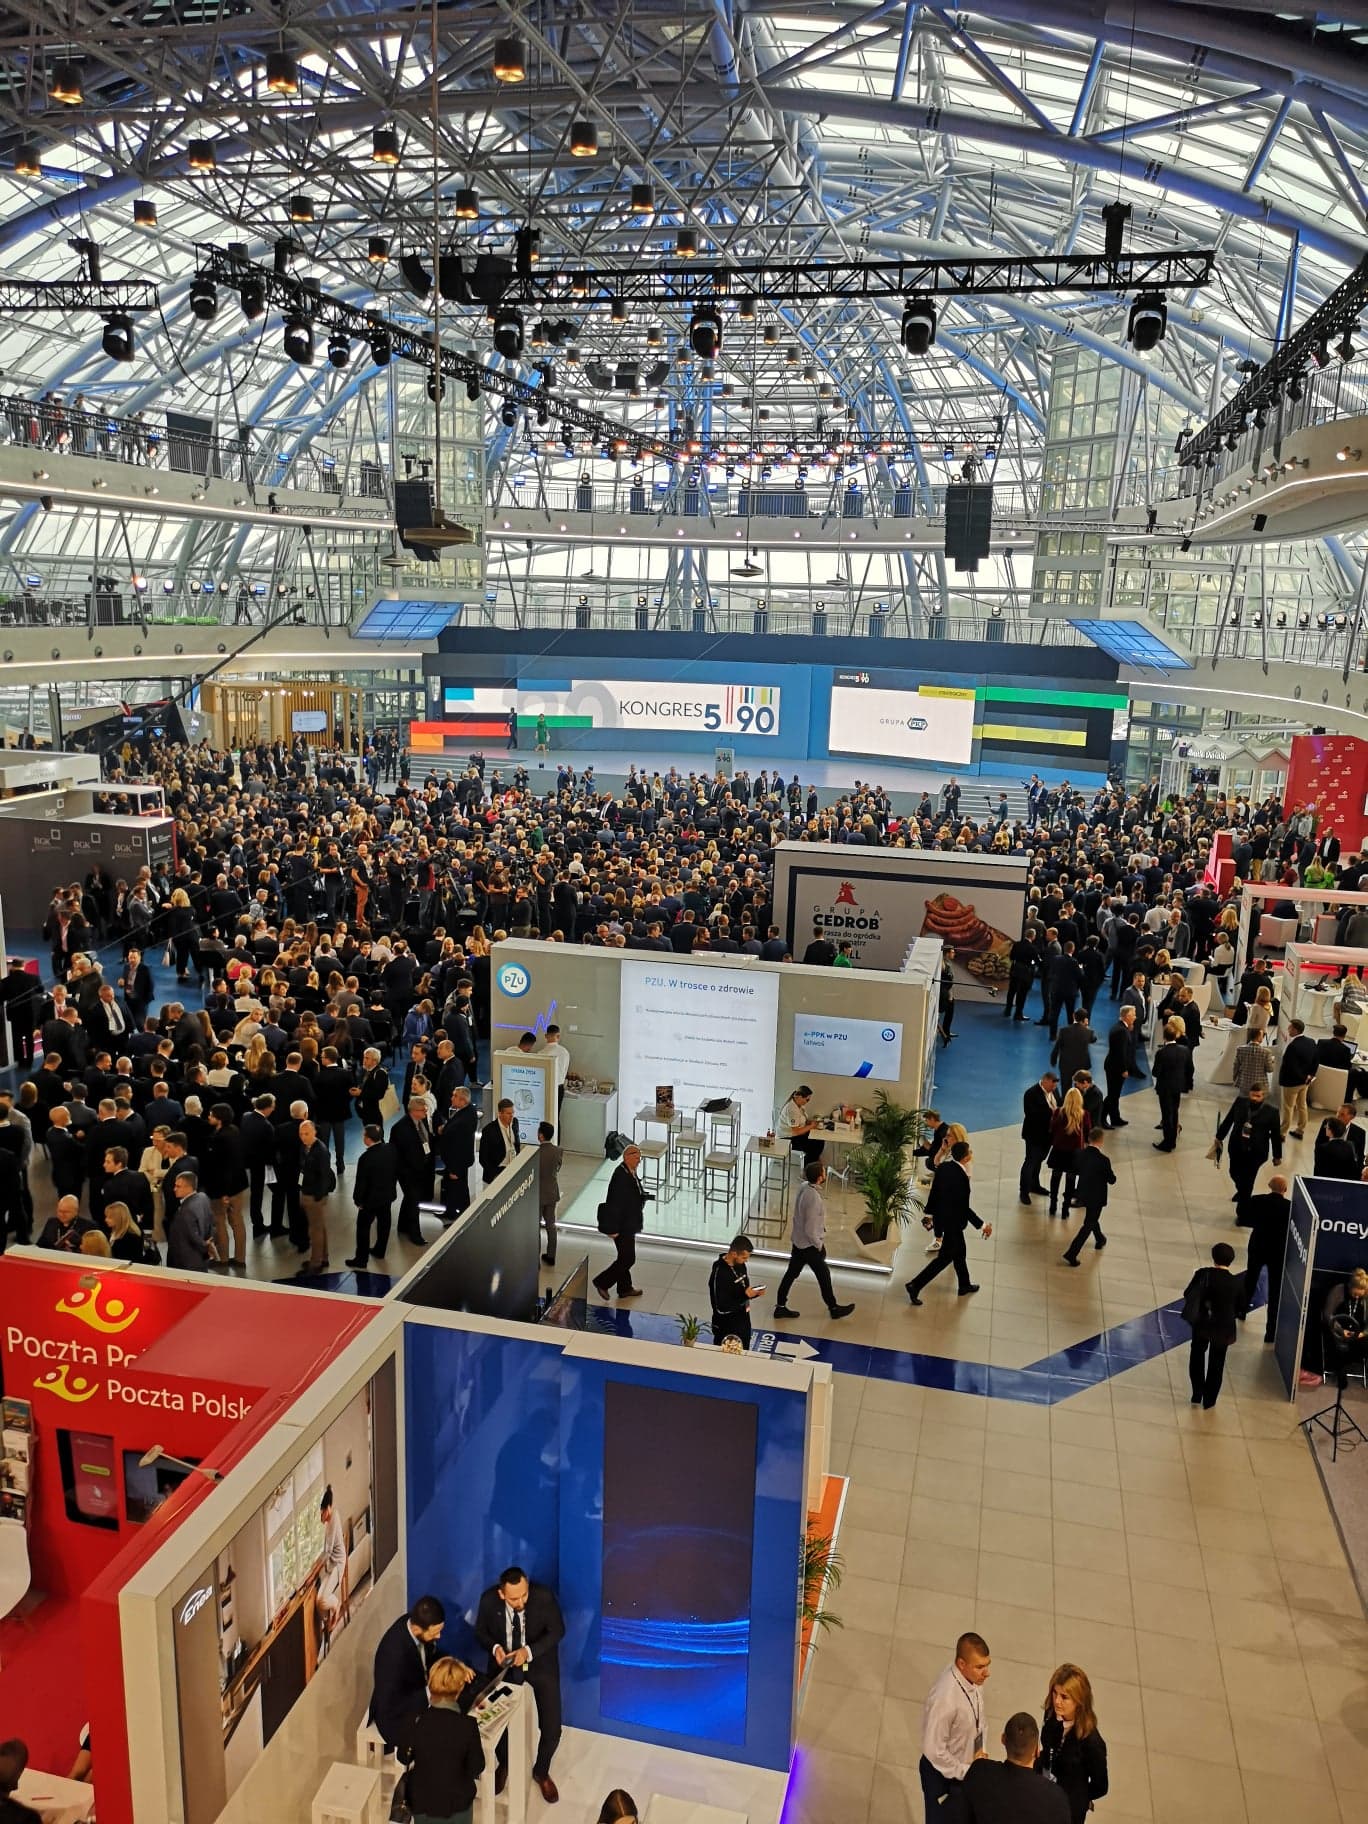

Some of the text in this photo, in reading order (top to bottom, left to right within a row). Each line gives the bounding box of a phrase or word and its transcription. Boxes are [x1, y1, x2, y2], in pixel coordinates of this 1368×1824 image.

[619, 700, 703, 718] KONGRES
[880, 718, 905, 726] GRUPA
[73, 840, 91, 849] BGK
[114, 843, 133, 853] BGK
[813, 905, 880, 917] GRUPA
[813, 913, 880, 930] CEDROB
[504, 972, 524, 988] PZU
[668, 979, 678, 988] W
[680, 980, 709, 991] trosce
[710, 984, 716, 992] o
[718, 984, 755, 995] zdrowie
[833, 1033, 848, 1041] PZU
[1317, 1218, 1368, 1240] oney
[7, 1326, 98, 1365] Poczta
[107, 1379, 252, 1420] Poczta Polsk
